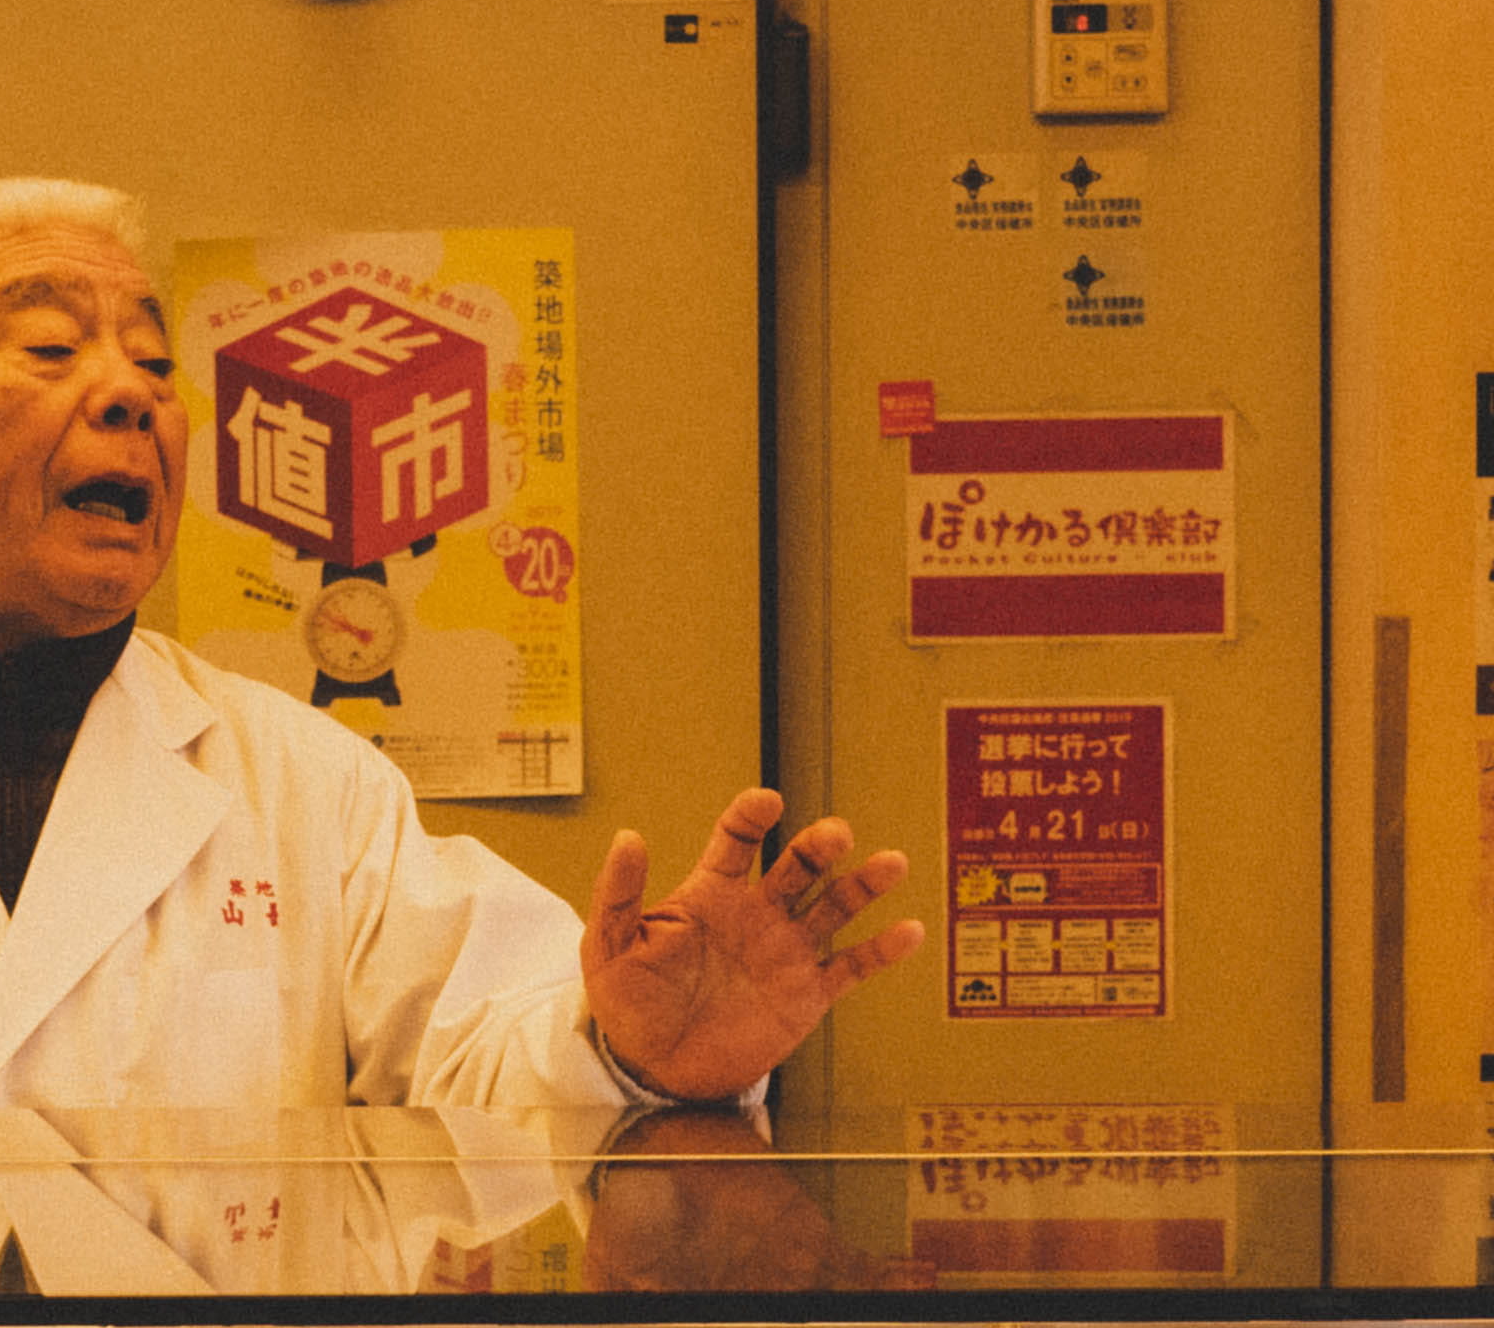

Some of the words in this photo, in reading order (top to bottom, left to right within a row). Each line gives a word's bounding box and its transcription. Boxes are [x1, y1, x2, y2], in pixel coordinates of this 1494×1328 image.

[534, 260, 565, 464] 築地場外市場
[919, 479, 1220, 550] ぽけかる倶楽部
[521, 537, 559, 591] 20
[978, 734, 1132, 761] 選挙に行って
